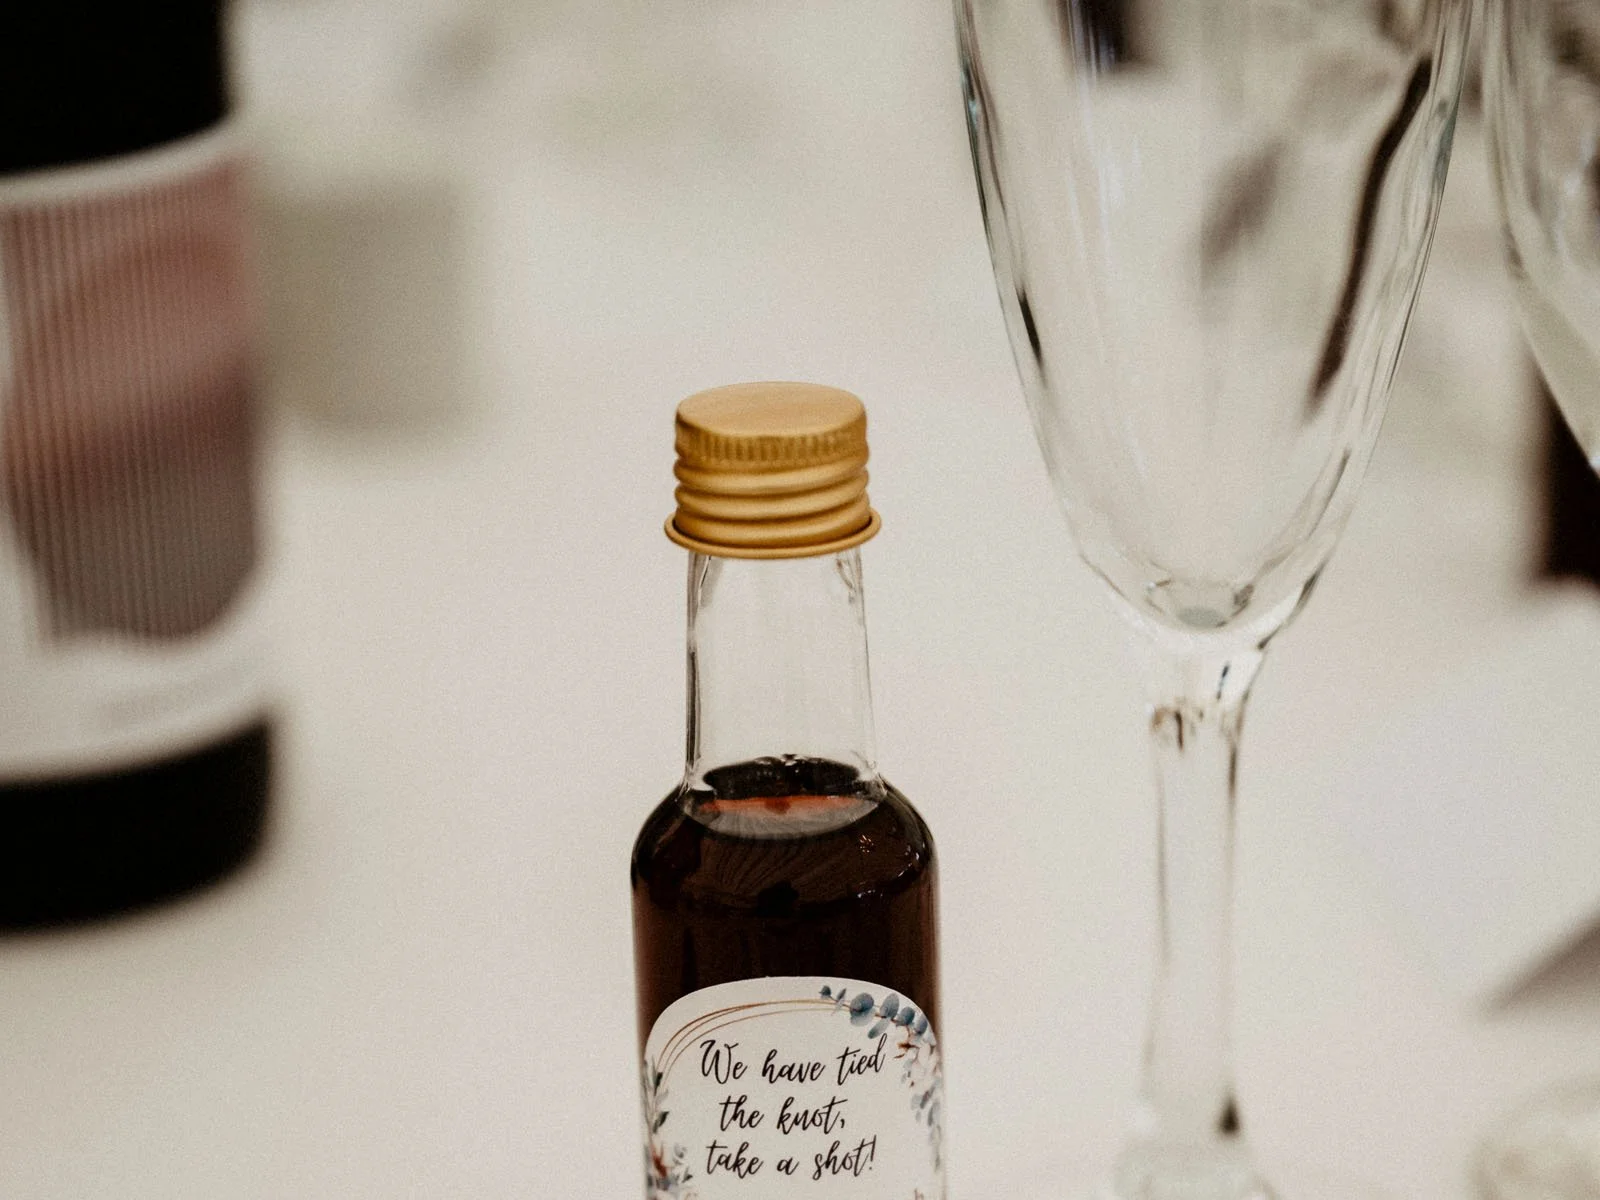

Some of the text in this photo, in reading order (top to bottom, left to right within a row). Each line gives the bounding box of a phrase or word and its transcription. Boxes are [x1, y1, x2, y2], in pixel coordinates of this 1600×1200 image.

[700, 1034, 888, 1085] We have tied
[719, 1095, 849, 1135] the knot,
[706, 1136, 878, 1181] take a shot!
